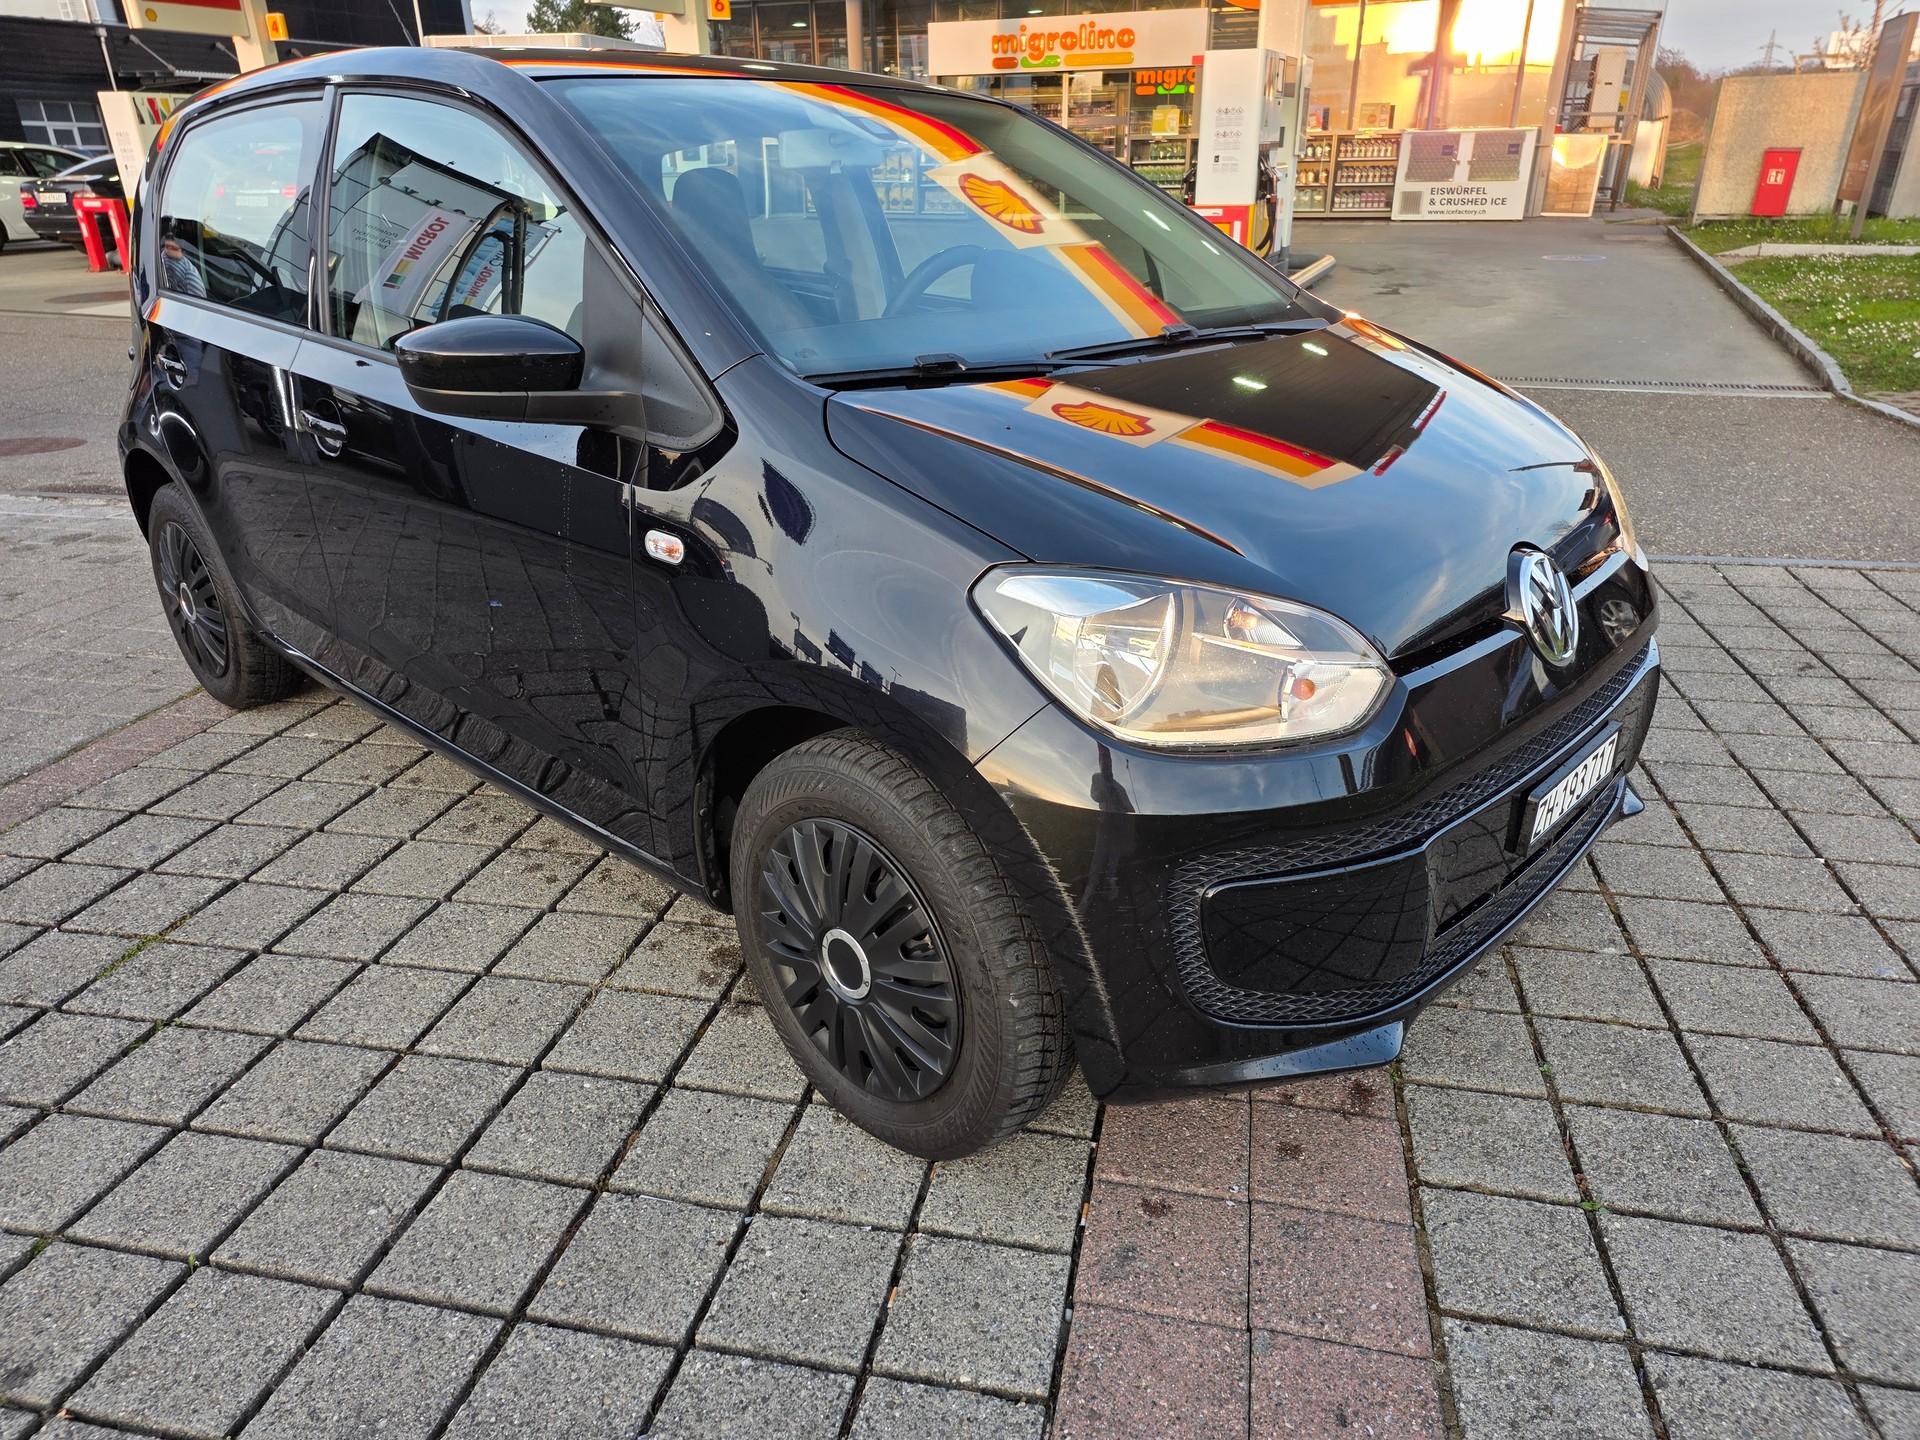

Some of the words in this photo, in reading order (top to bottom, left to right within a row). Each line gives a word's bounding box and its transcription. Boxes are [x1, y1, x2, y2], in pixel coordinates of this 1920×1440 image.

[715, 0, 725, 12] 6
[271, 20, 279, 33] 4
[991, 21, 1136, 61] migrolino
[1430, 185, 1488, 196] EISWÜRFEL
[1429, 198, 1437, 207] &
[1439, 197, 1488, 206] CRUSHED
[1490, 197, 1508, 206] ICE
[1427, 208, 1487, 216] www.icefactory.ch
